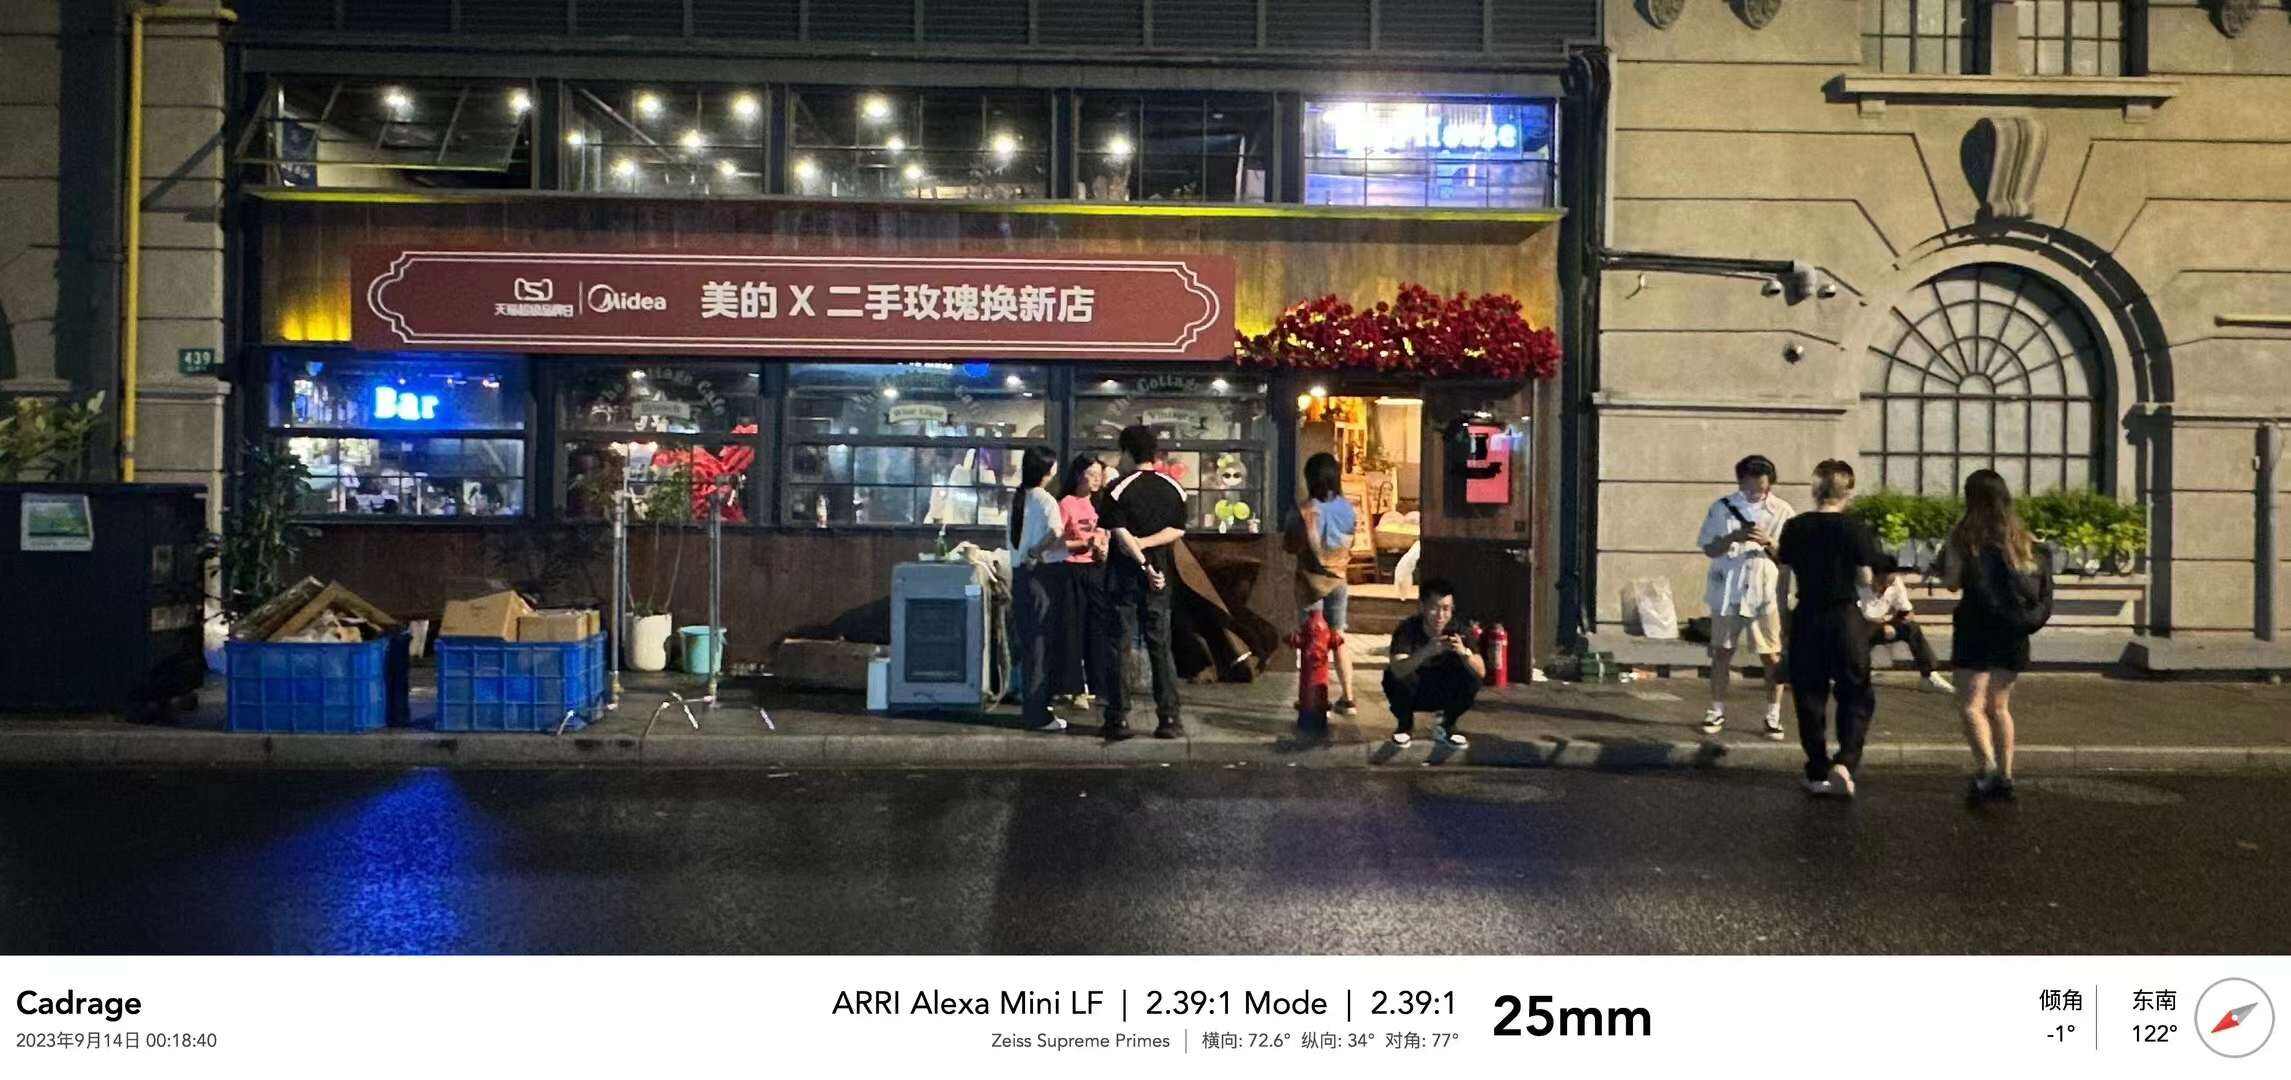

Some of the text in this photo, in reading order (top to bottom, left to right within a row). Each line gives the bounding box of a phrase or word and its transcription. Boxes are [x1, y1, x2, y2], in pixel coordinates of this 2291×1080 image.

[588, 284, 667, 313] Midea
[701, 281, 1095, 323] 美的 X 二手玫瑰换新店
[185, 351, 211, 366] 439
[374, 386, 440, 421] Bar
